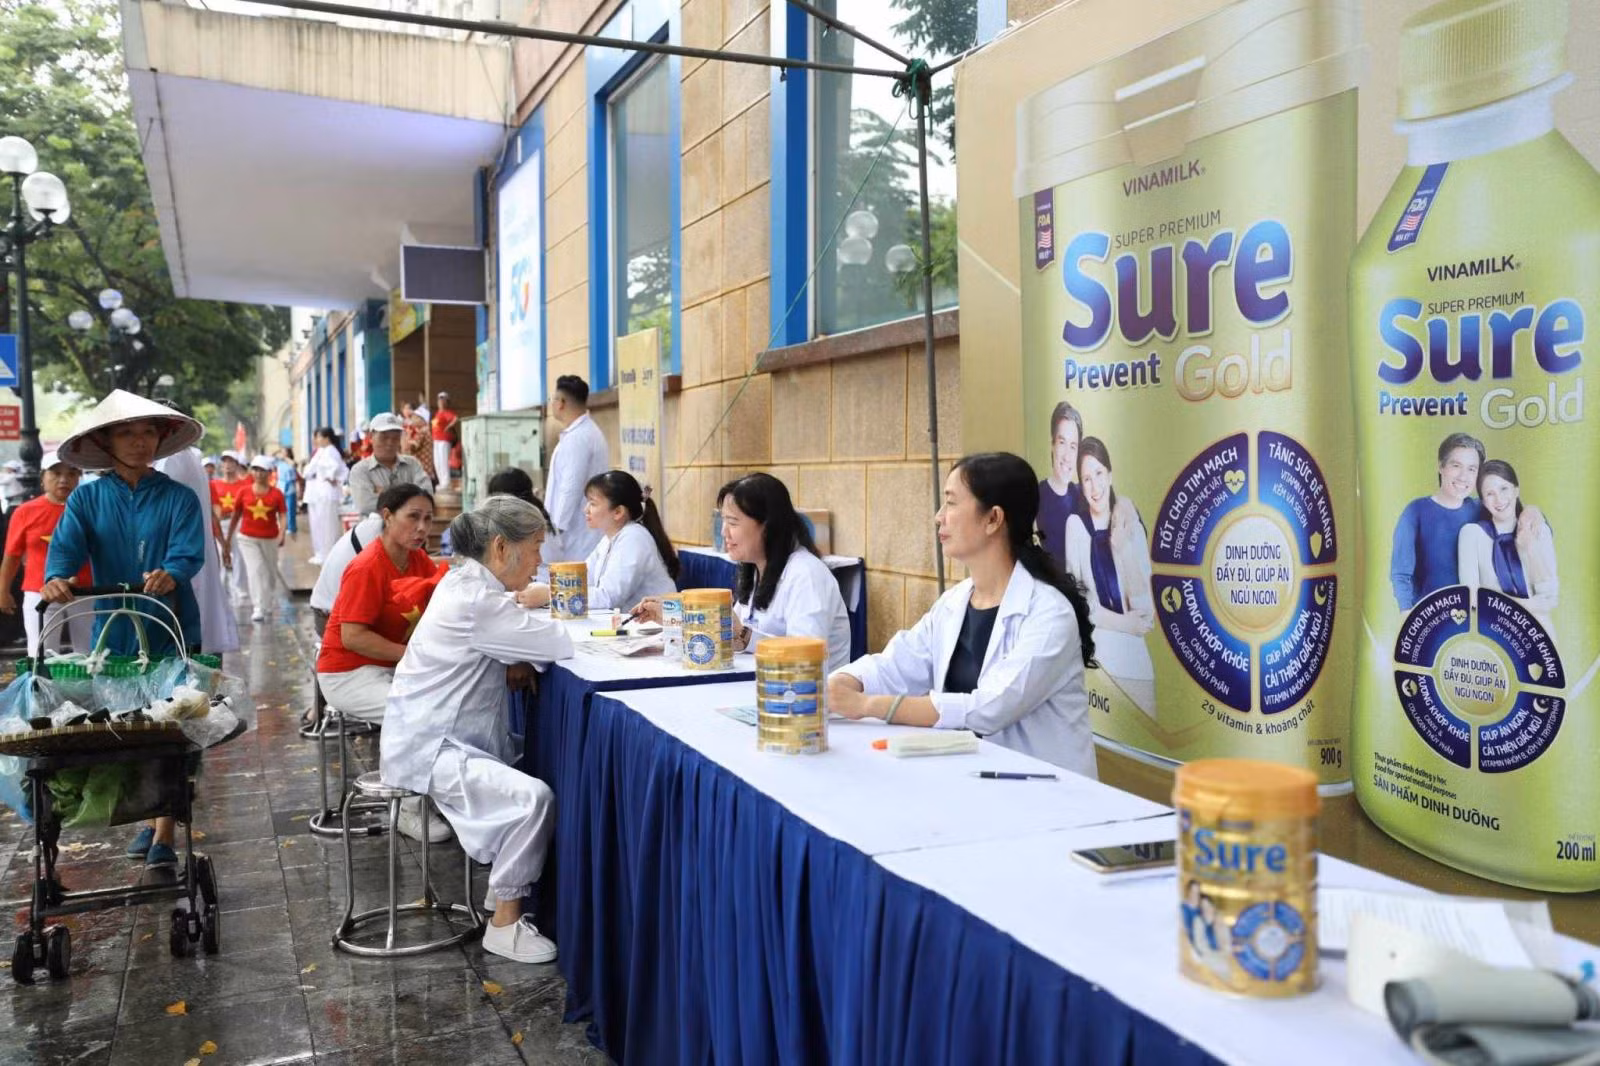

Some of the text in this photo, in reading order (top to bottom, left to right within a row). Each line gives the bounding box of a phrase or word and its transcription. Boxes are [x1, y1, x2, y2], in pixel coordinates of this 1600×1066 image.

[1123, 159, 1201, 197] VINAMILK
[1115, 209, 1222, 249] SUPER PREMIUM
[1061, 217, 1294, 351] Sure
[1427, 254, 1515, 282] VINAMILK
[1428, 291, 1525, 315] SUPER PREMIUM
[1377, 296, 1585, 385] Sure
[1065, 328, 1293, 402] Prevent Gold
[1379, 377, 1585, 430] Prevent Gold
[1160, 446, 1238, 549] TỐT CHO TIM MẠCH
[1269, 441, 1296, 466] TĂNG
[1295, 457, 1312, 482] SỨC
[1317, 497, 1333, 549] KHÁNG
[1280, 468, 1301, 493] VITAMIN
[1174, 530, 1186, 559] STEROL
[1181, 502, 1199, 529] ESTERS
[1190, 514, 1206, 543] OMEGA
[1203, 508, 1211, 517] 3
[1213, 491, 1228, 507] DHA
[1293, 502, 1308, 528] SELEN
[1226, 542, 1281, 560] DINH DƯỠNG
[1238, 563, 1253, 583] ĐỦ,
[1255, 564, 1275, 582] GIÚP
[1278, 564, 1289, 582] ĂN
[1231, 585, 1277, 605] NGỦ NGON
[1264, 690, 1290, 706] VITAMIN
[1288, 677, 1306, 696] NHÓM
[1320, 581, 1334, 643] TRYPTOPHAN
[1265, 649, 1281, 665] GIÚP
[1291, 609, 1311, 645] NGON,
[1401, 594, 1461, 655] TỐT CHO TIM MẠCH
[1487, 596, 1512, 615] TĂNG
[1512, 611, 1530, 630] SỨC
[1537, 641, 1558, 678] KHÁNG
[1497, 615, 1519, 634] VITAMIN
[1170, 622, 1194, 662] COLLAGEN
[1209, 676, 1230, 695] PHÂN
[1190, 637, 1215, 669] CANXI &
[1265, 669, 1279, 689] CẢI
[1278, 658, 1302, 683] THIỆN
[1309, 611, 1323, 642] NGỦ
[1451, 657, 1498, 674] DINH DƯỠNG
[1510, 639, 1526, 659] SELEN
[1454, 685, 1494, 702] NGỦ NGON
[1201, 699, 1316, 735] 29 vitamin & khoáng chất
[1408, 702, 1427, 731] COLLAGEN
[1481, 728, 1498, 741] GIÚP
[1508, 708, 1530, 731] NGON,
[1482, 743, 1496, 757] CẢI
[1495, 741, 1518, 755] THIỆN
[1527, 714, 1543, 735] NGỦ
[1541, 699, 1560, 738] TRYPTOPHAN
[1320, 747, 1342, 768] 900 g
[1402, 763, 1415, 773] dinh
[1374, 762, 1457, 799] Food for special medical purposes
[1391, 784, 1419, 806] PHẨM
[1421, 796, 1450, 816] DINH
[1452, 806, 1500, 831] DƯỠNG
[1194, 828, 1288, 873] Sure
[1556, 840, 1596, 861] 200 ml
